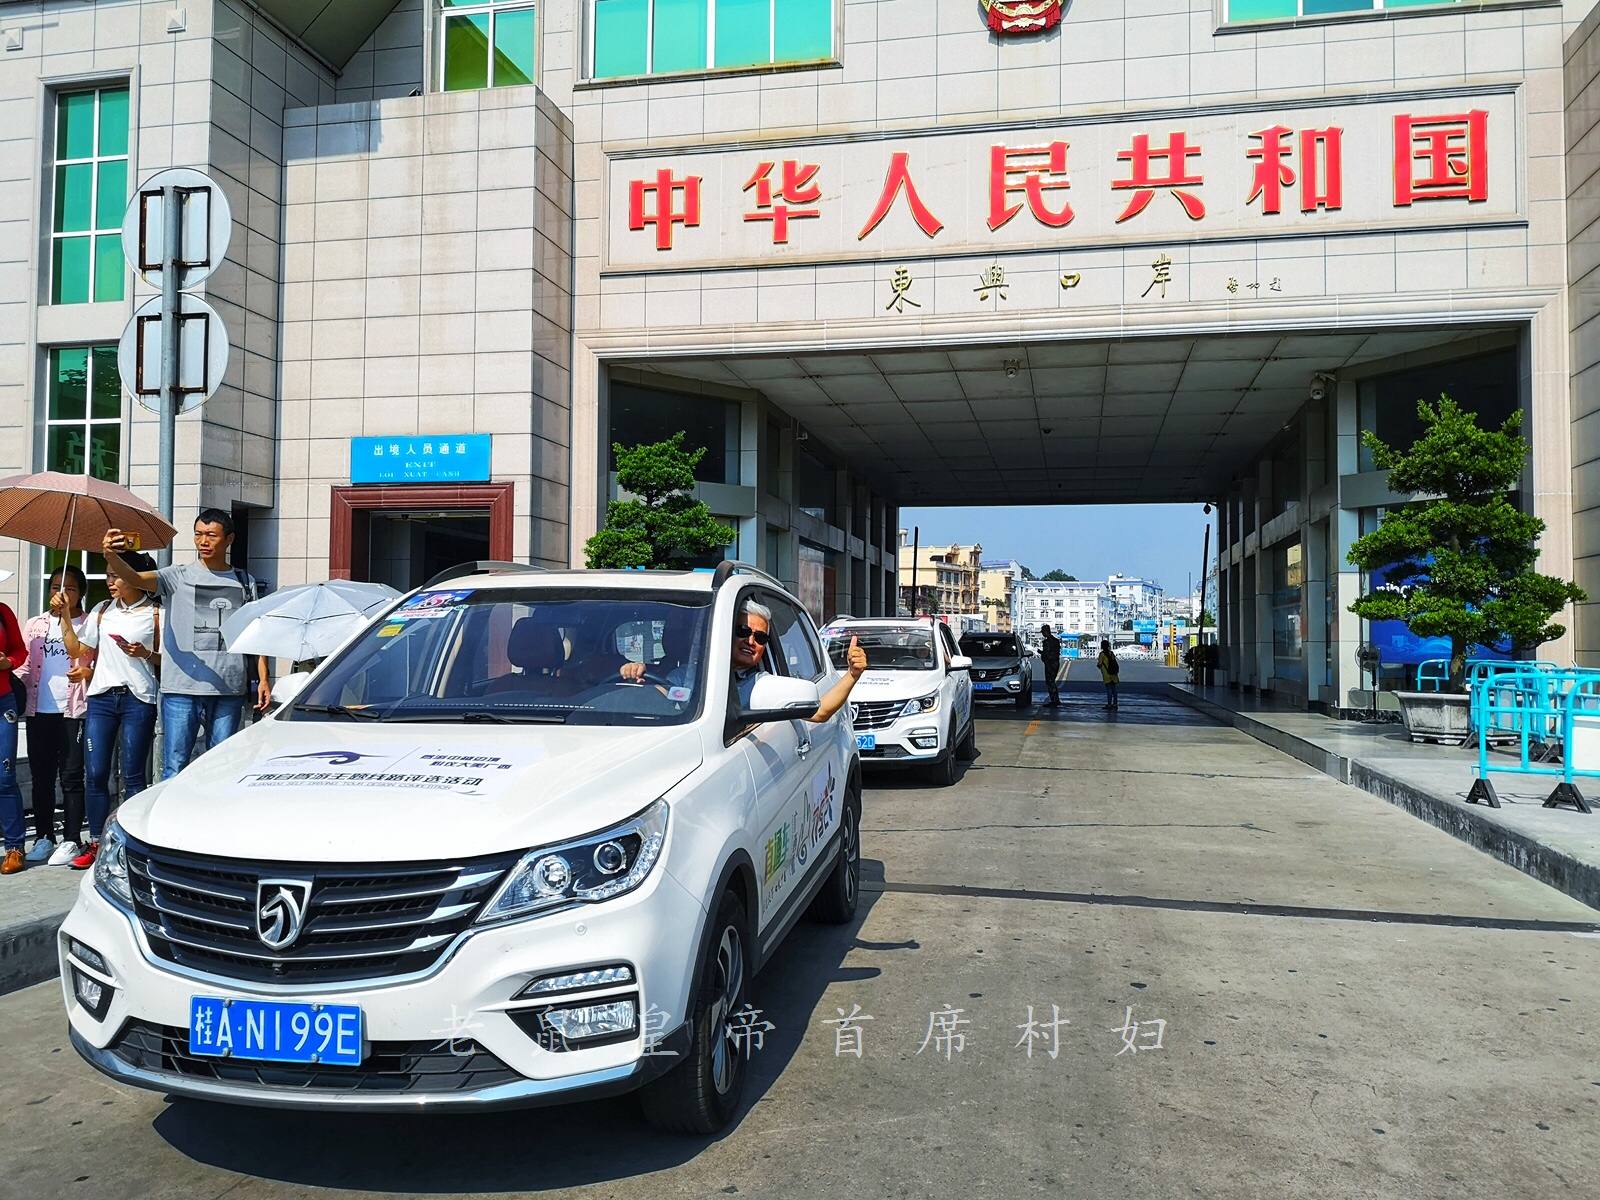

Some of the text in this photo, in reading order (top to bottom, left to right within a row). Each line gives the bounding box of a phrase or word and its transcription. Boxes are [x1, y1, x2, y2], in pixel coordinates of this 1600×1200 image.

[628, 109, 1490, 250] 中华人民共和国
[373, 443, 467, 456] 出境人员通道
[405, 461, 436, 469] EXIT
[237, 773, 484, 786] 广西自驾游主题线路评选活动
